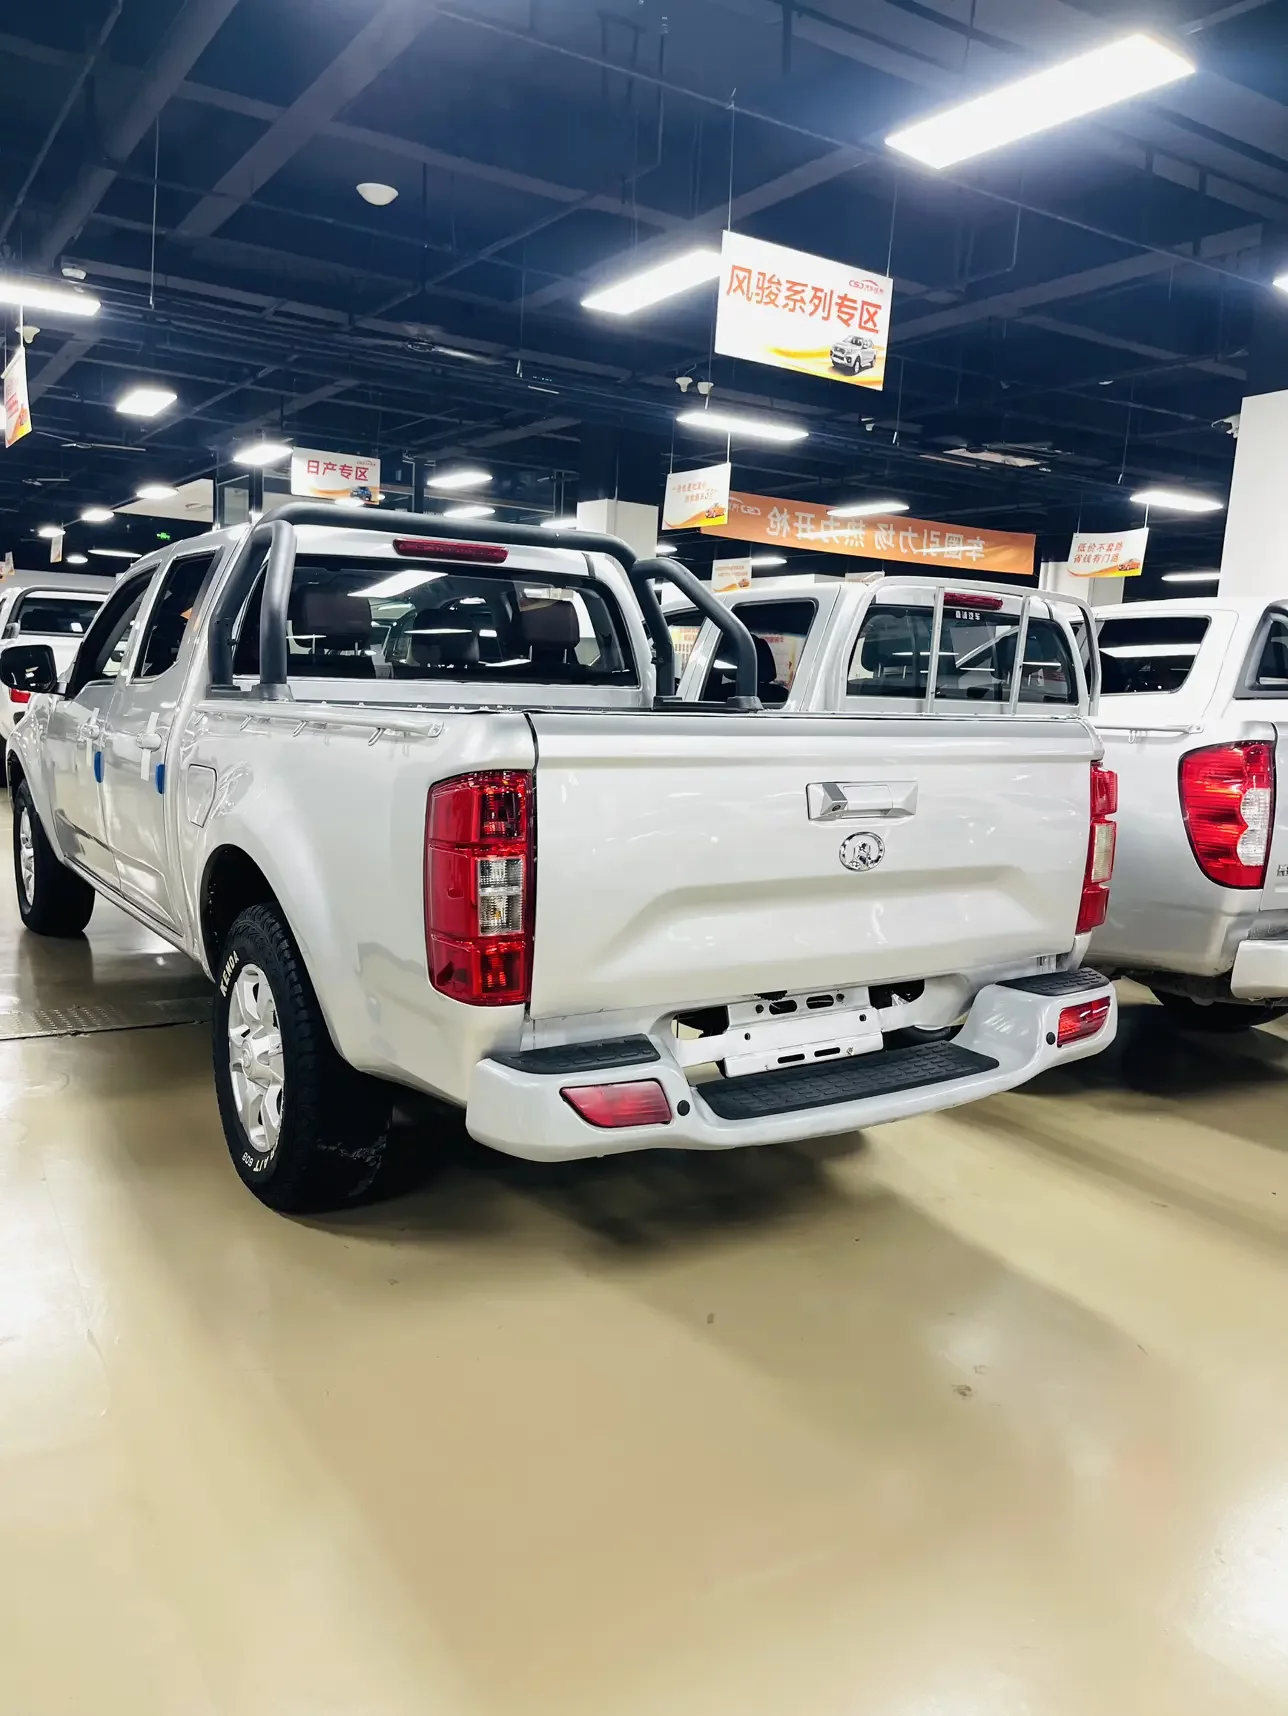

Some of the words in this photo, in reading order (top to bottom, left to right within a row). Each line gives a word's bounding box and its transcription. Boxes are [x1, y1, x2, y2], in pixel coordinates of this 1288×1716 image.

[726, 264, 882, 335] 风骏系列专区
[307, 460, 369, 482] 日产专区
[1077, 541, 1123, 553] 低价不套路
[220, 950, 240, 997] KENDA
